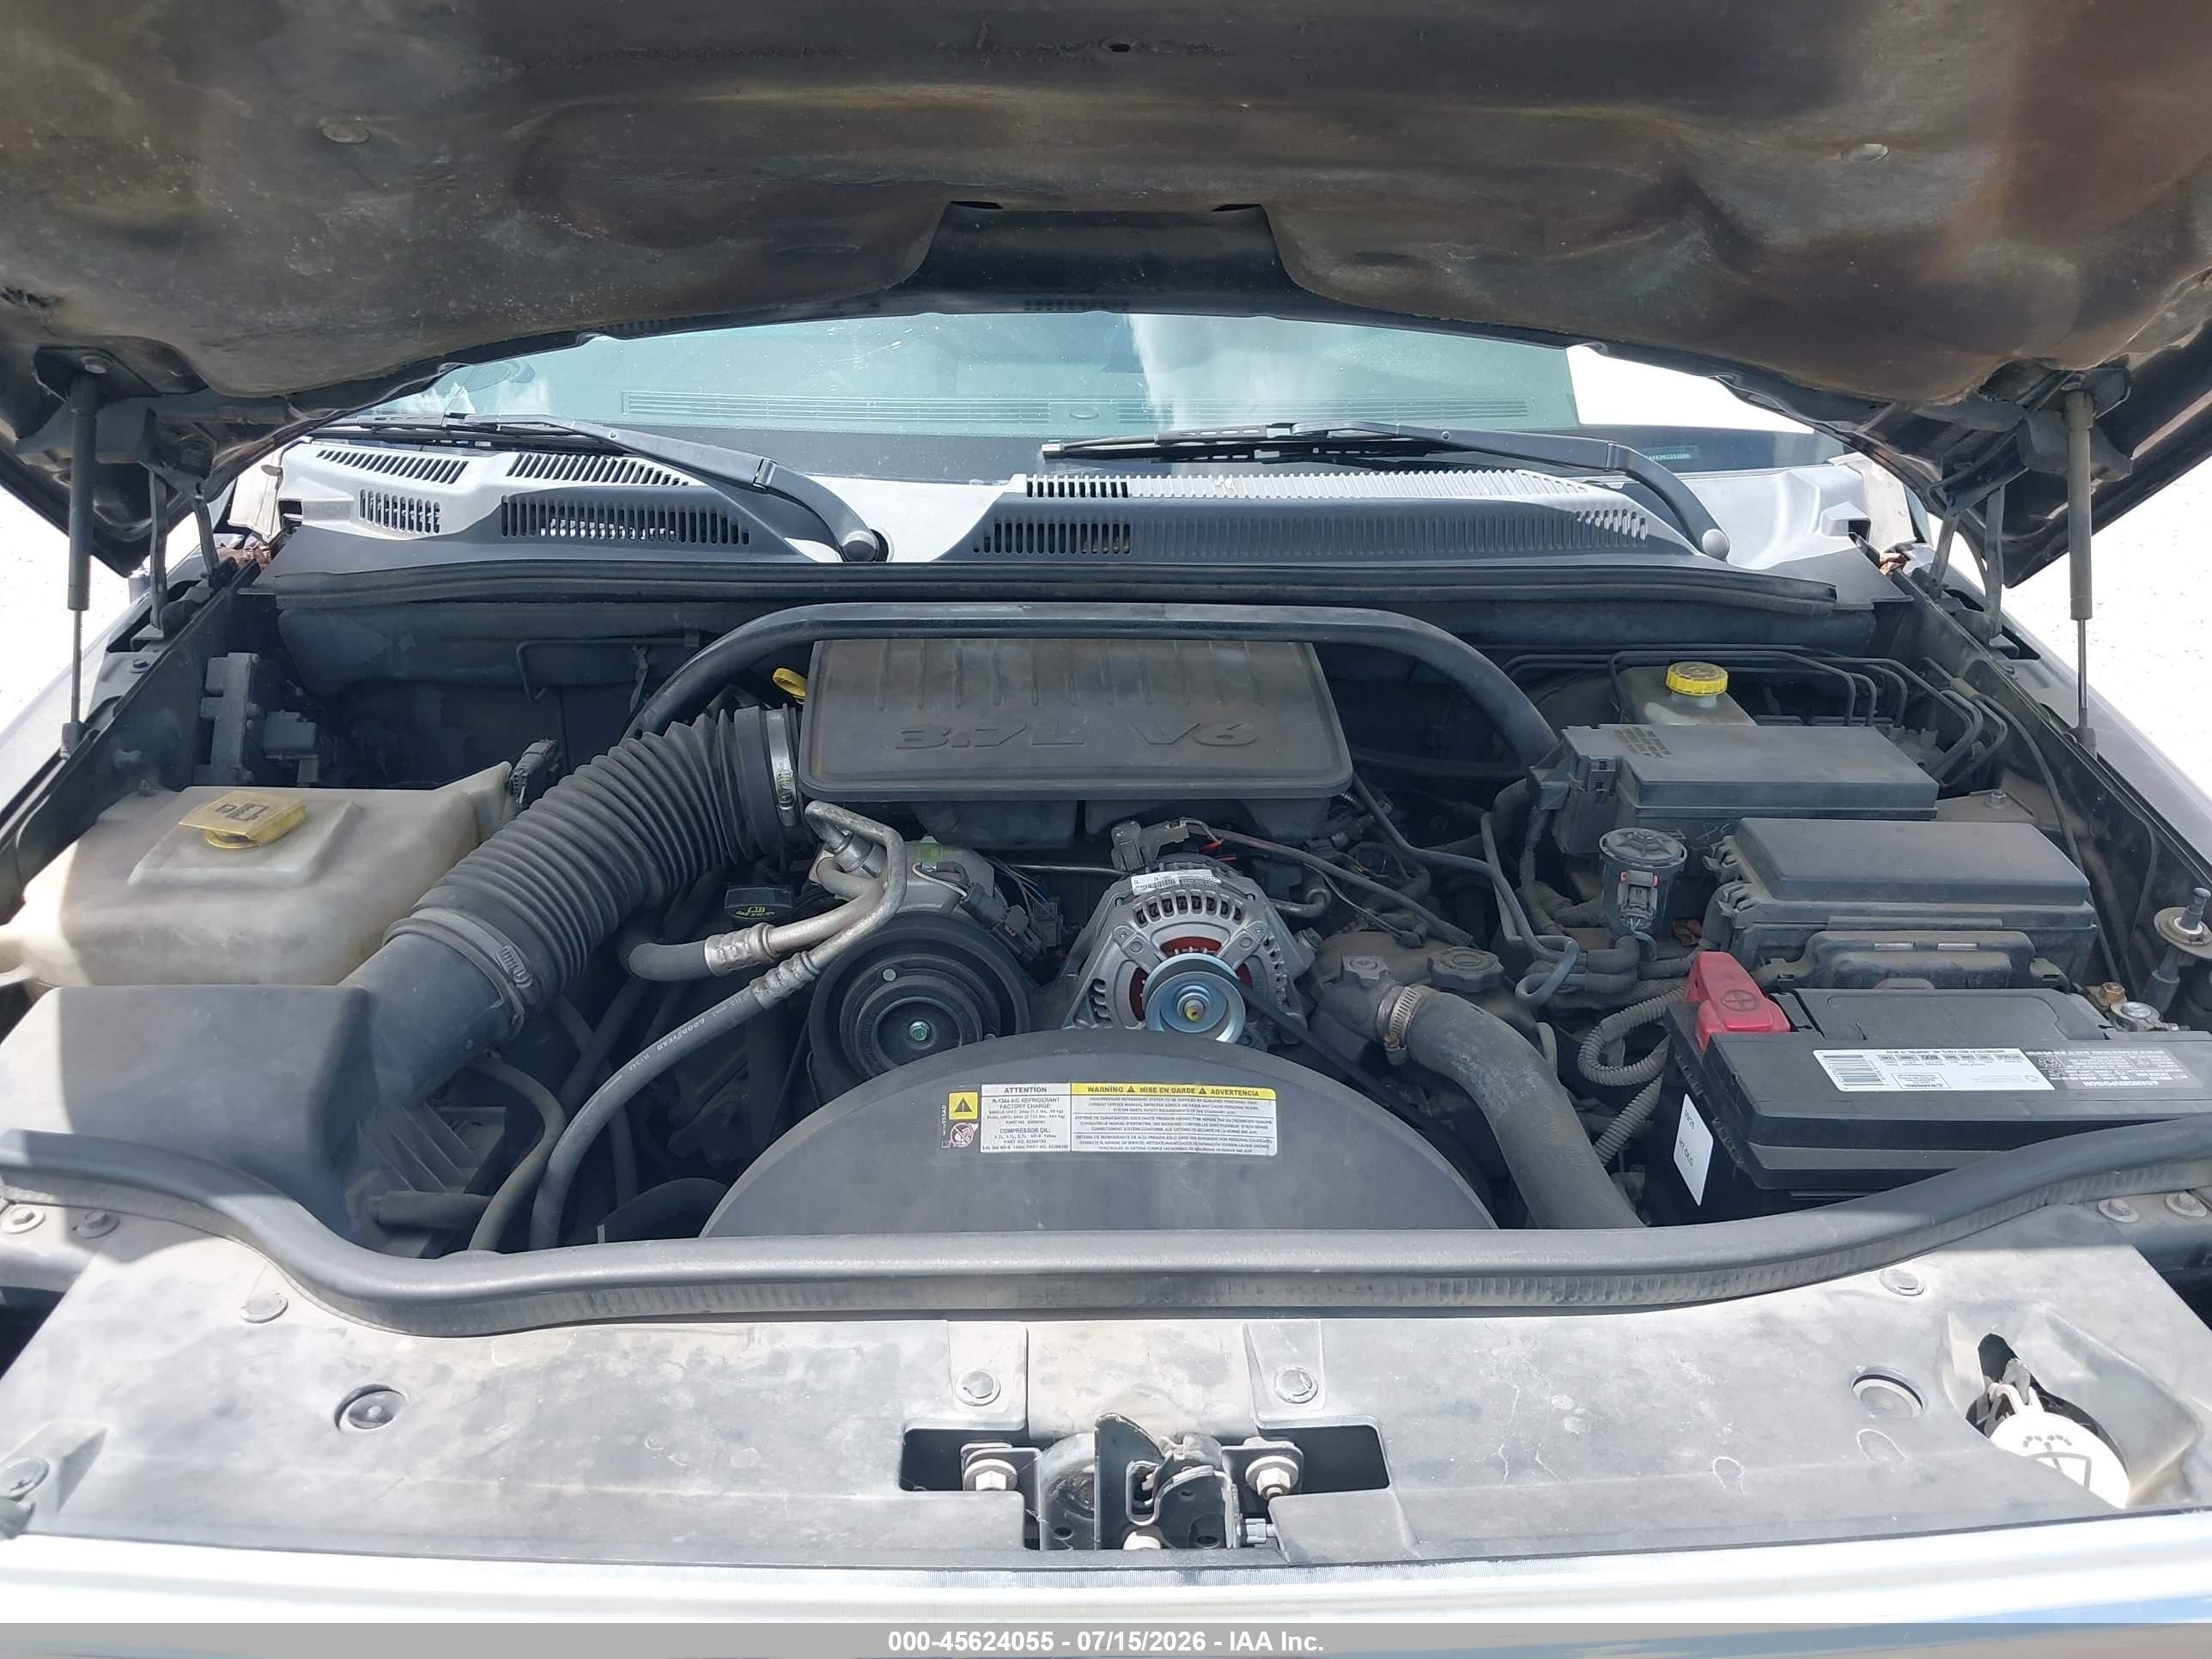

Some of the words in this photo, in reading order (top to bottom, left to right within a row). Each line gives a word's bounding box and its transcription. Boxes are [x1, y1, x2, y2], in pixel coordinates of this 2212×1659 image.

[894, 721, 1087, 750] 3.7L
[1129, 721, 1260, 748] V6
[656, 1017, 707, 1052] GOODYEAR
